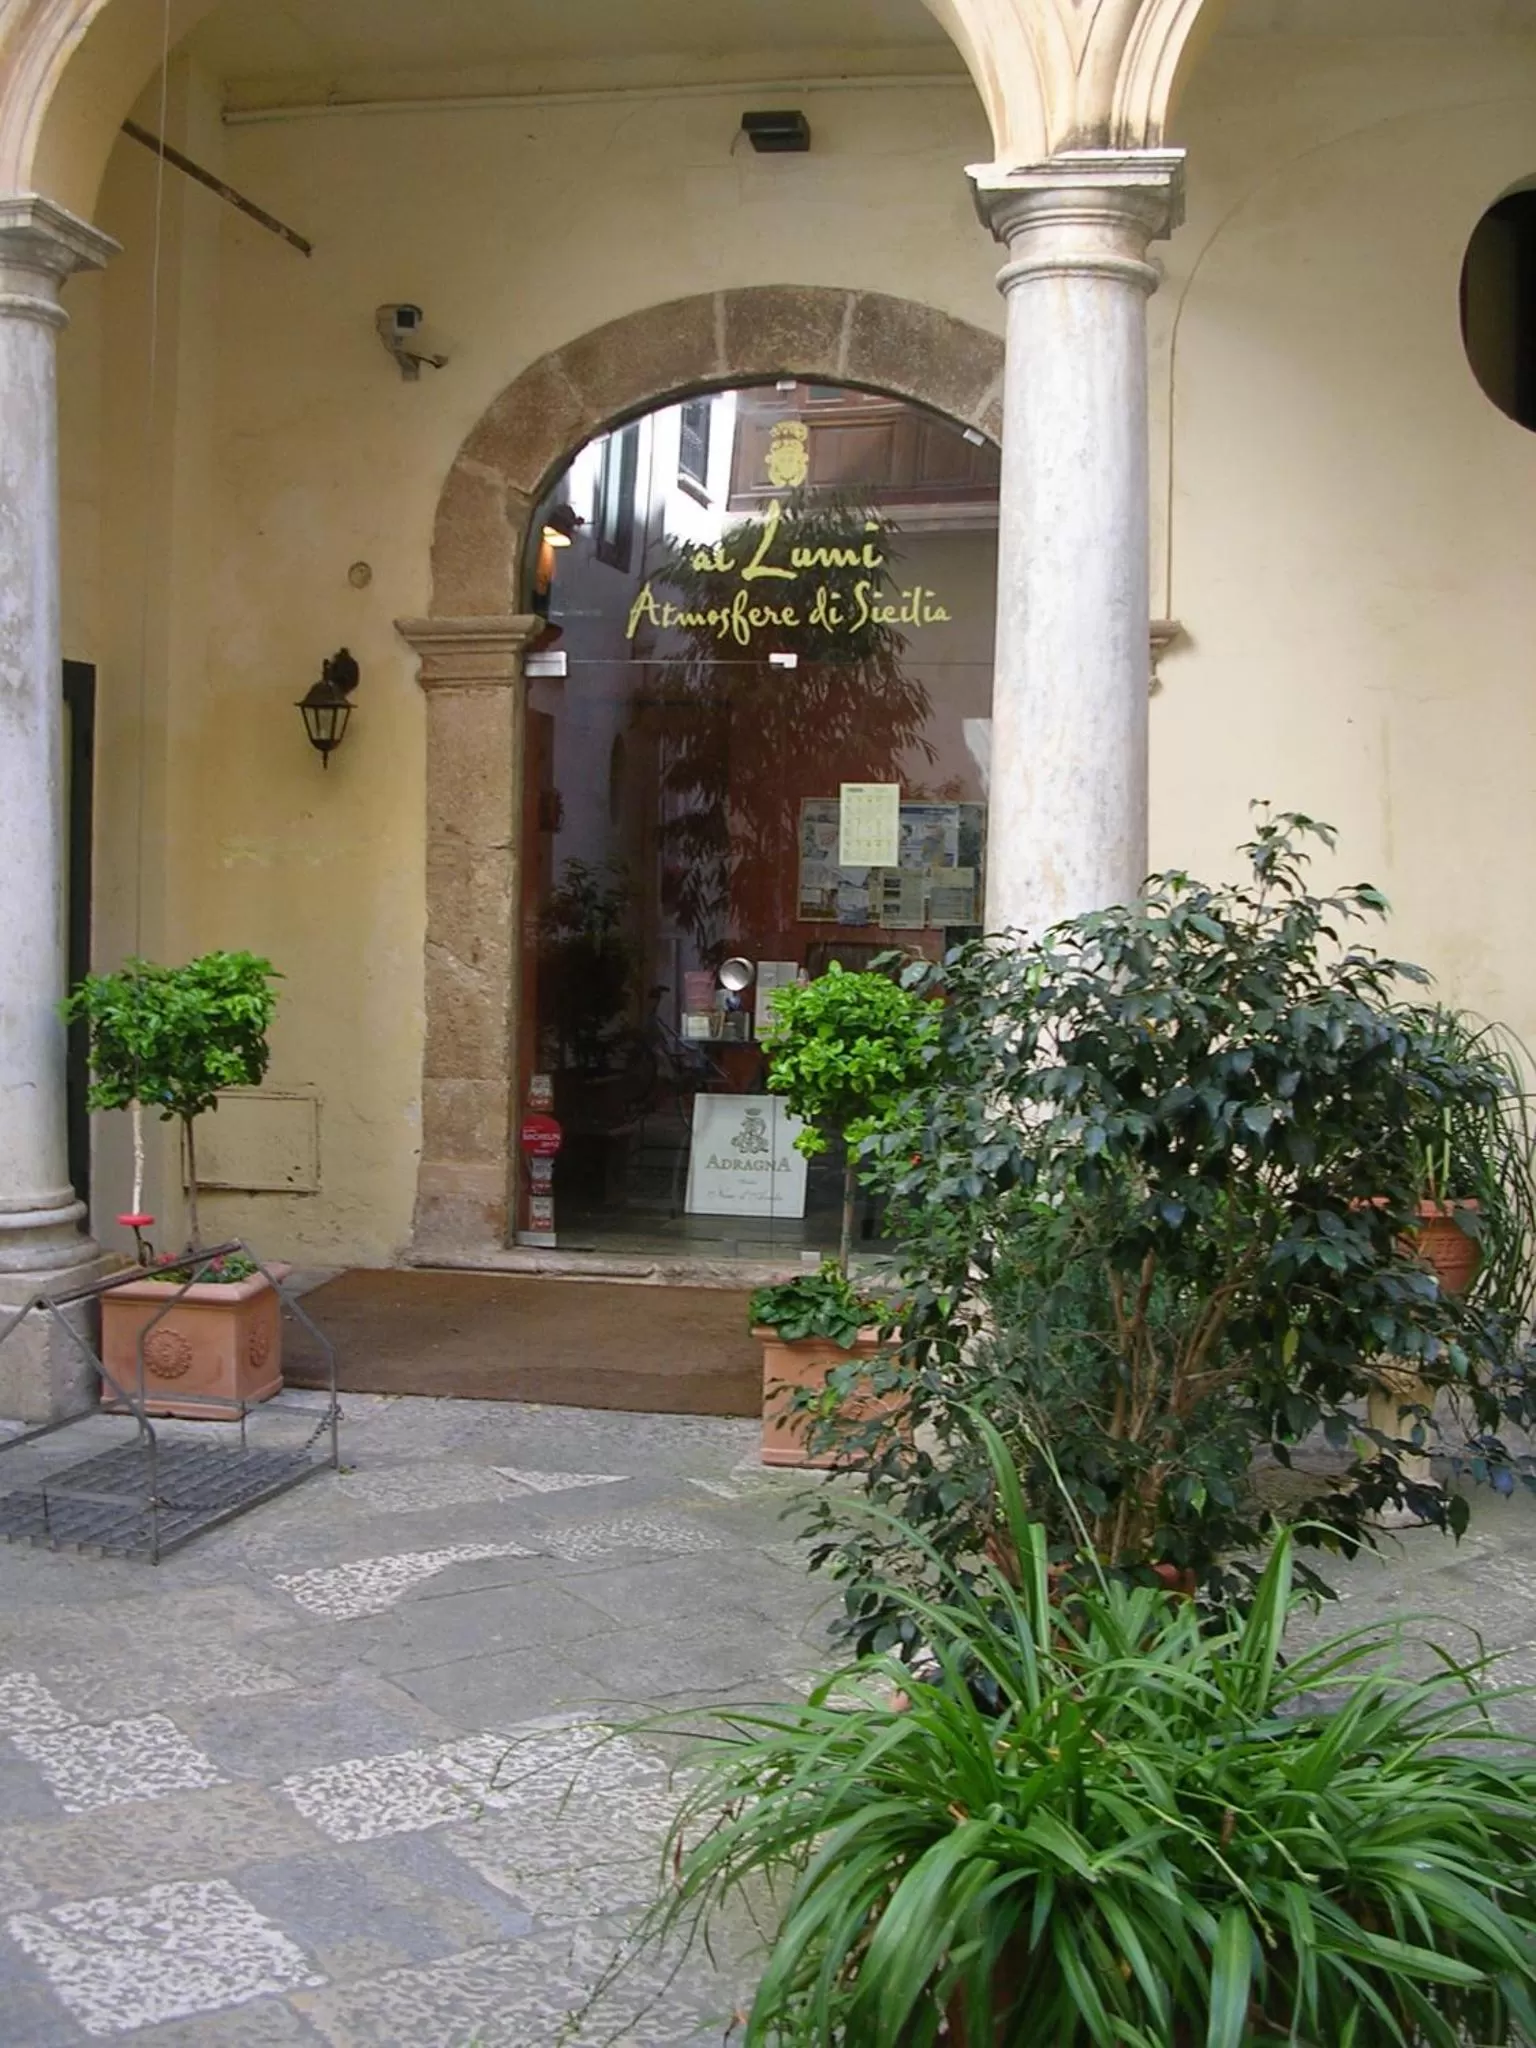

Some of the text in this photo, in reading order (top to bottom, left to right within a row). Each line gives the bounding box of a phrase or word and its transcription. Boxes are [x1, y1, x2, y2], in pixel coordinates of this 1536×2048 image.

[692, 499, 884, 581] ai Lumi
[625, 581, 951, 646] Atmosfere di Sicilia
